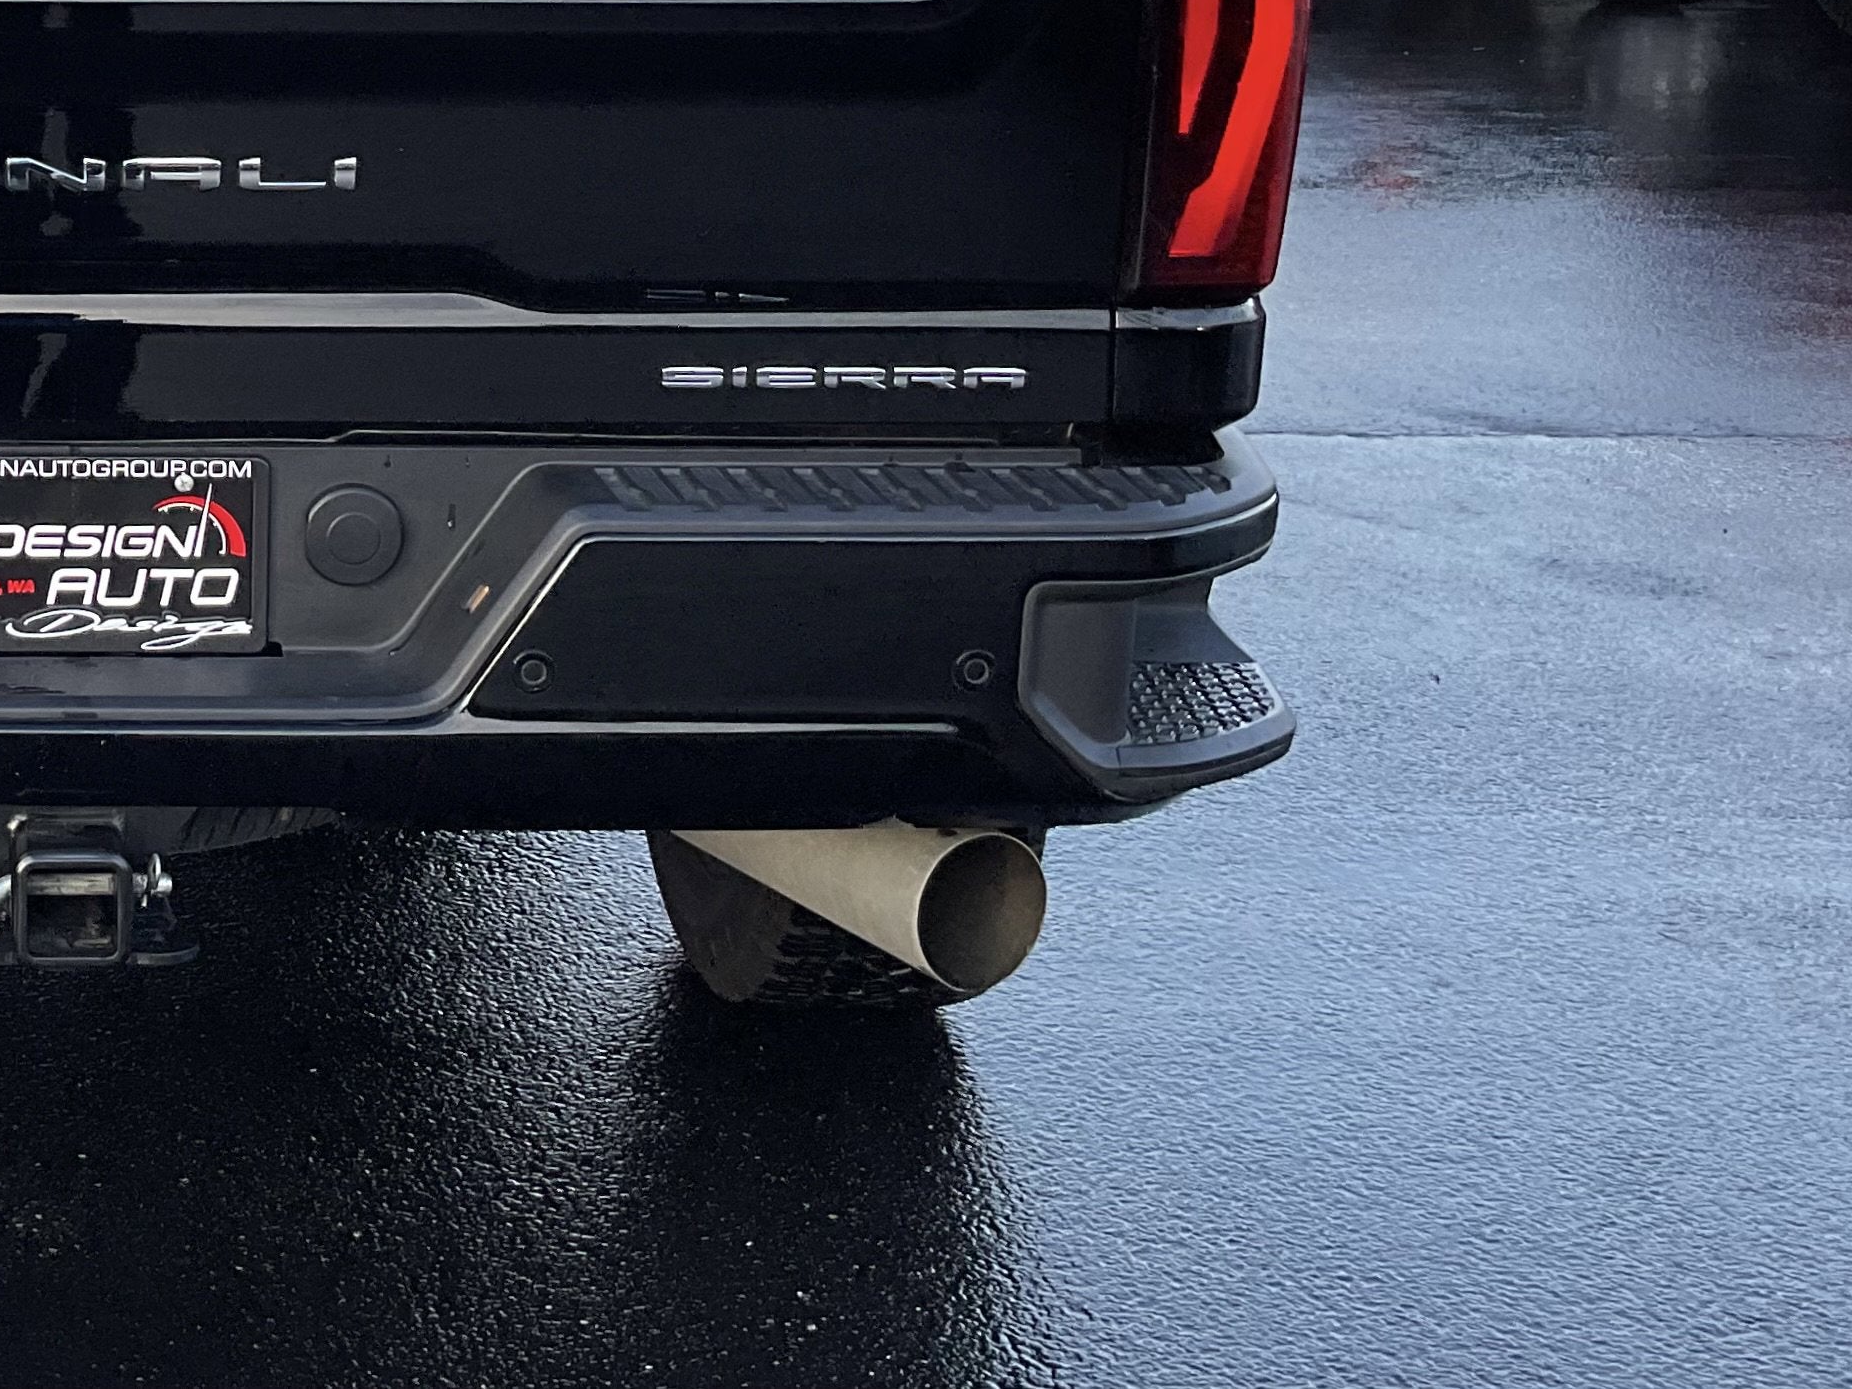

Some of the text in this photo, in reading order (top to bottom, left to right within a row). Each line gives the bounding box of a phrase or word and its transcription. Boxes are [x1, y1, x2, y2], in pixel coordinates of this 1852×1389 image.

[660, 365, 1028, 390] SIERRA
[7, 579, 35, 594] WA
[46, 568, 240, 607] AUTO
